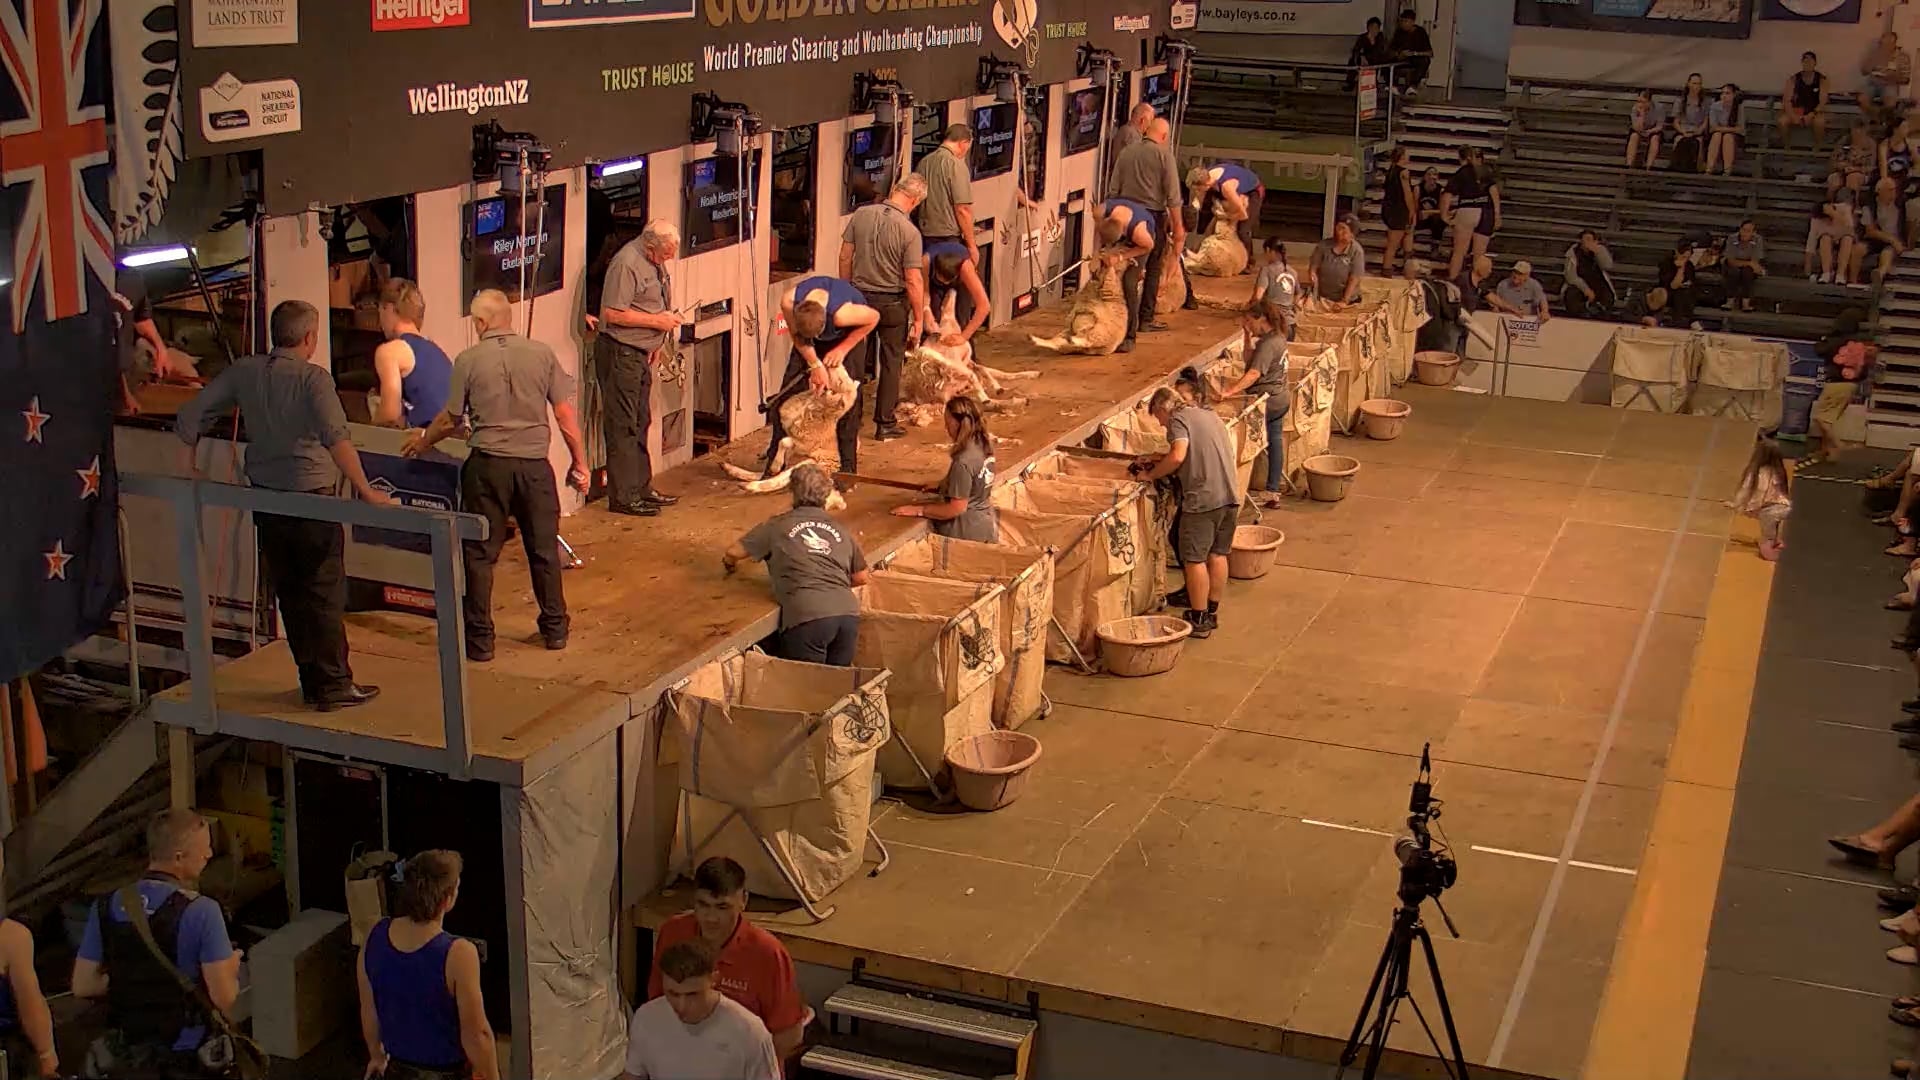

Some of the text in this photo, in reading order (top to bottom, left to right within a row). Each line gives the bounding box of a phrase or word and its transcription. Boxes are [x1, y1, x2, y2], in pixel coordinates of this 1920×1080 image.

[208, 10, 285, 25] LANDS TRUST
[704, 21, 983, 72] World Premier Shearing and Woolhandling Championship
[601, 62, 694, 92] TRUST HOUSE
[261, 88, 295, 101] NATIONAL
[408, 79, 529, 115] WellingtonNZ
[262, 113, 288, 125] CIRCUIT
[493, 238, 515, 255] Riley
[691, 235, 697, 248] 2
